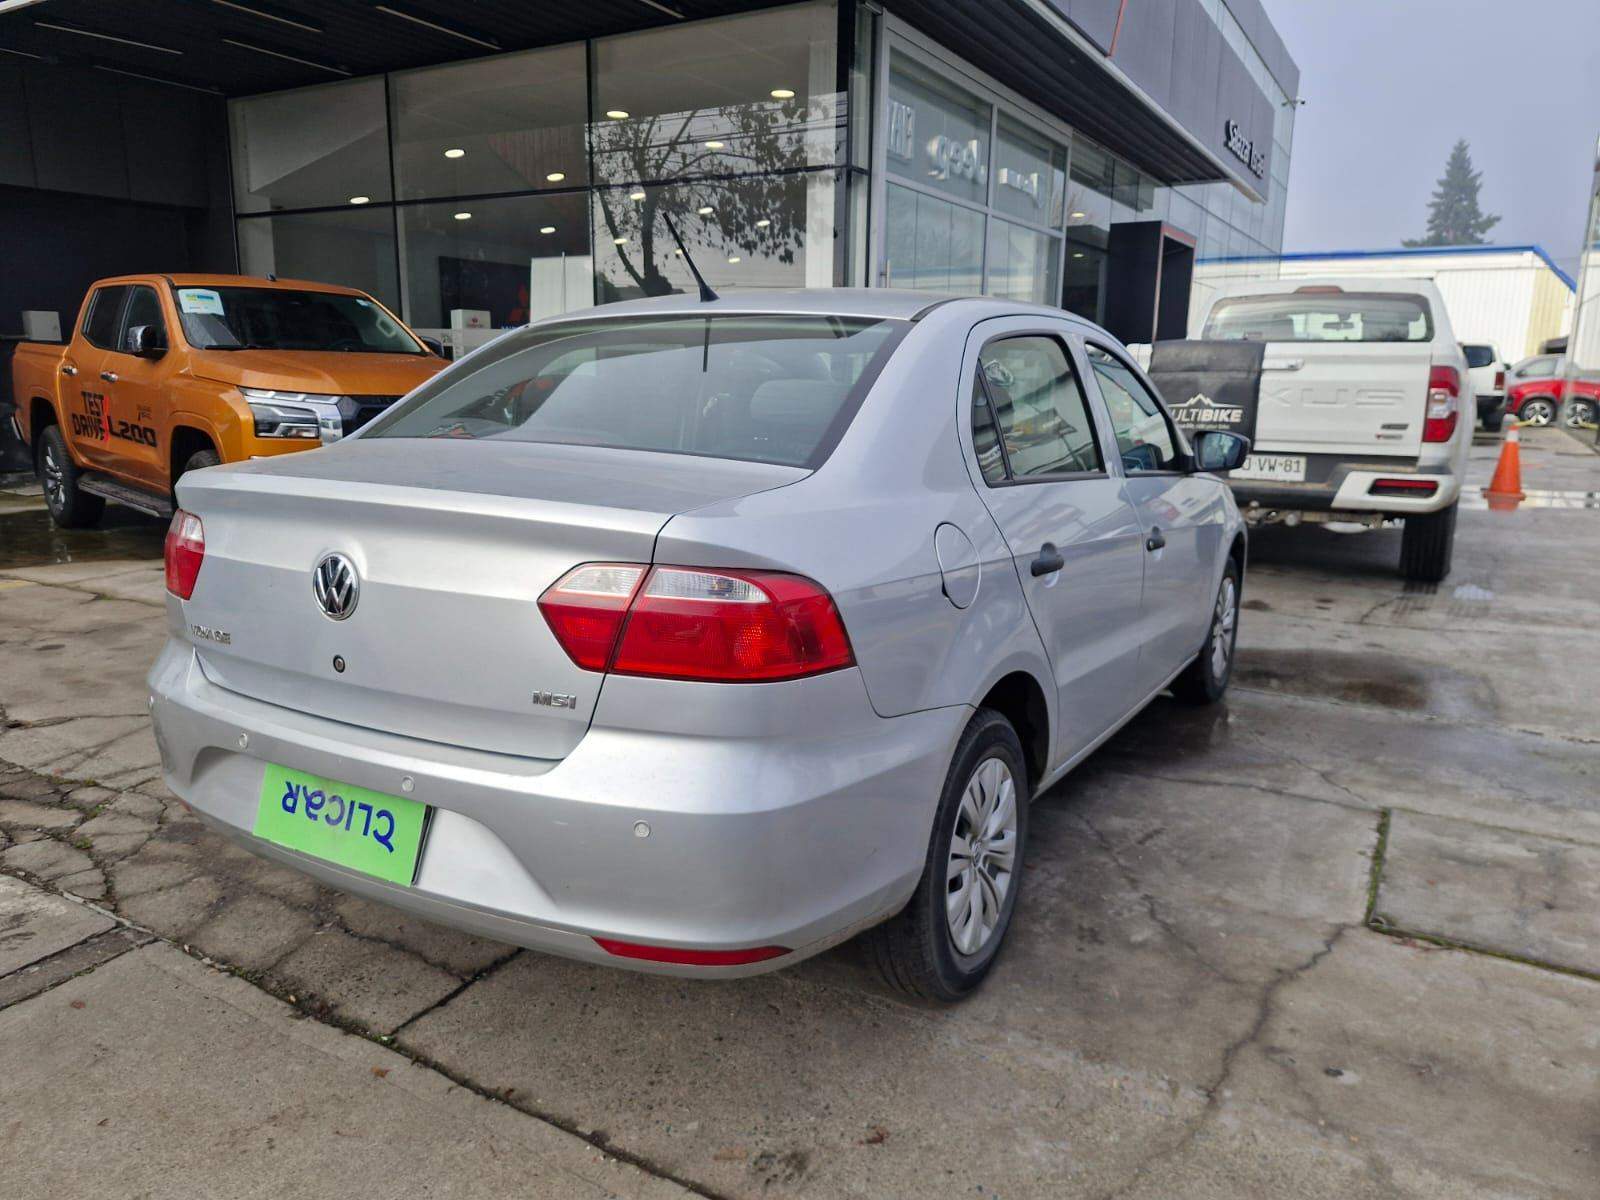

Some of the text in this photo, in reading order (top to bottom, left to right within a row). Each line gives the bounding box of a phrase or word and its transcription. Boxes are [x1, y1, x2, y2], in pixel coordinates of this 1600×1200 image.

[81, 391, 104, 416] TEST
[1263, 387, 1405, 408] XUS
[72, 413, 104, 440] DRIVE
[1171, 408, 1243, 423] ULTIBIKE
[107, 415, 156, 448] L200
[532, 690, 576, 709] MSI
